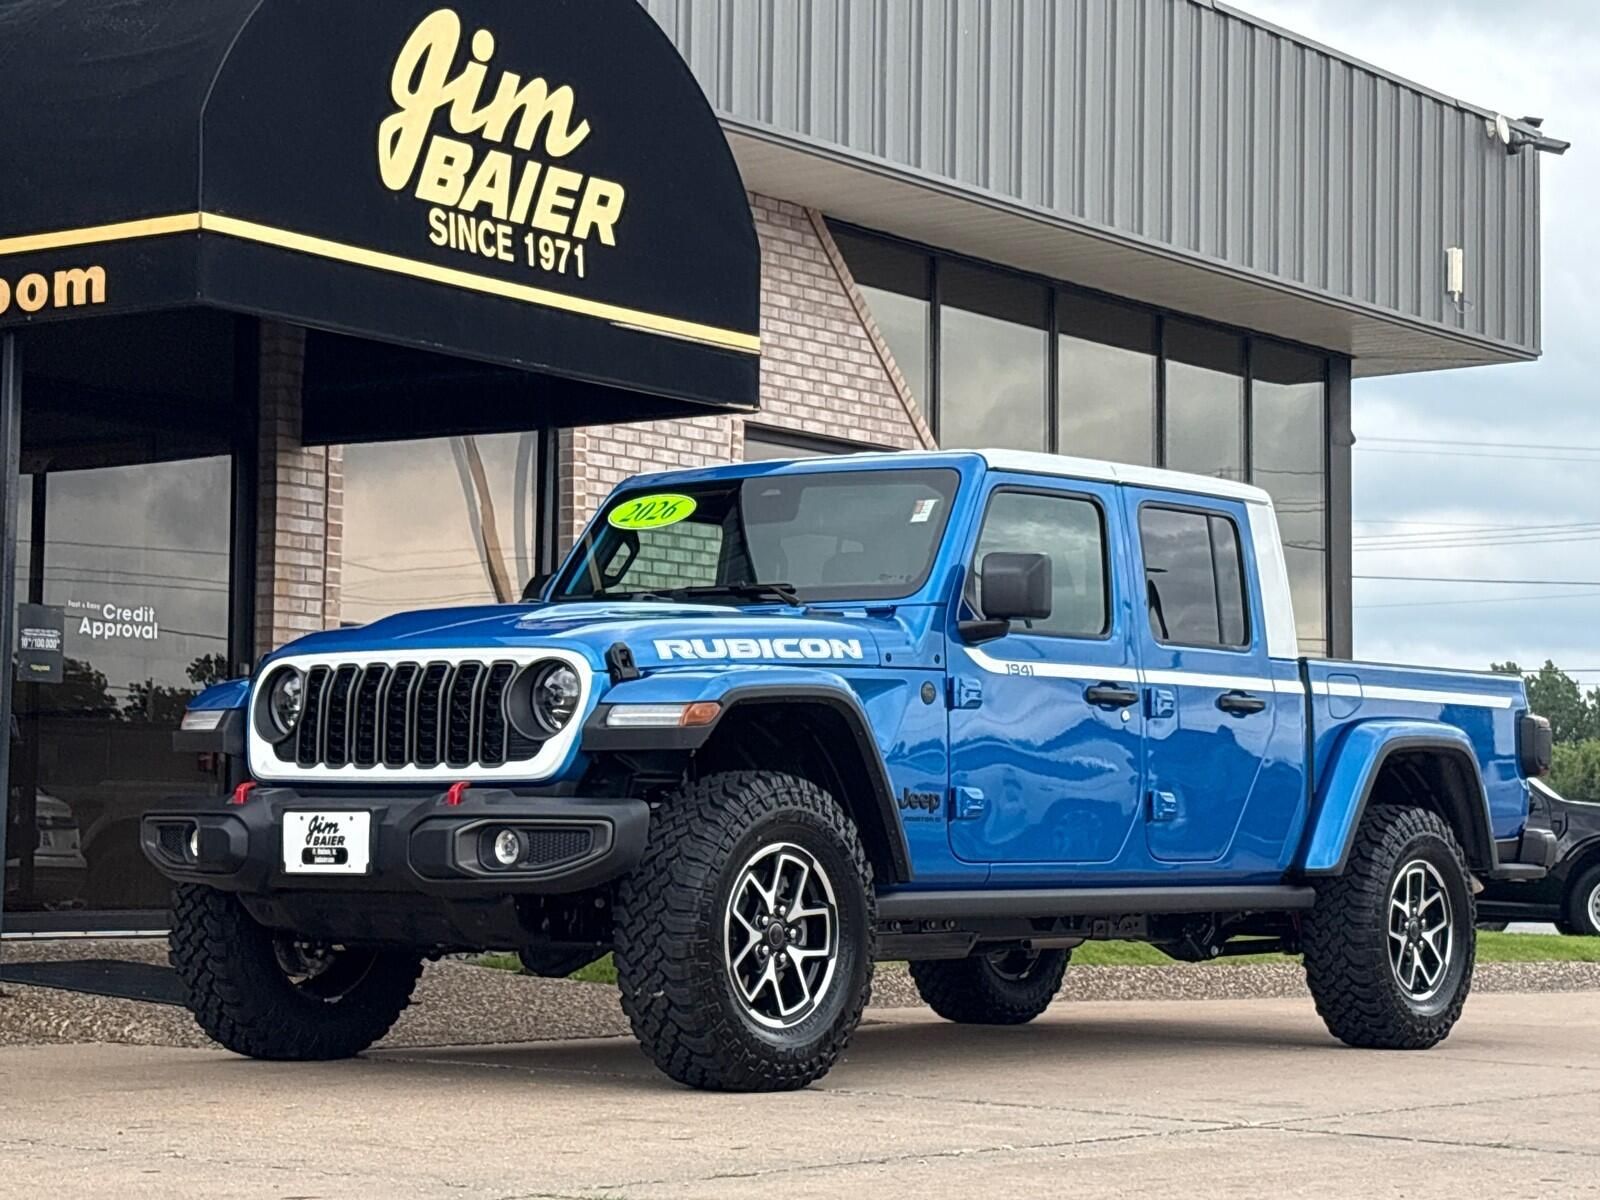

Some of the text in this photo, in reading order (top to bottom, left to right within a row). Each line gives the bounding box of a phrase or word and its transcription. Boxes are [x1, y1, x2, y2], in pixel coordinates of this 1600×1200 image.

[379, 9, 590, 190] Jim
[415, 135, 625, 246] BAIER
[429, 208, 584, 278] SINCE 1971
[619, 500, 682, 522] 2026
[103, 604, 155, 622] Credit
[79, 616, 158, 640] Approval
[653, 639, 863, 660] RUBICON
[1006, 664, 1034, 676] 1941
[897, 787, 941, 814] Jeep
[305, 815, 339, 846] Jim
[313, 836, 345, 846] BAIER
